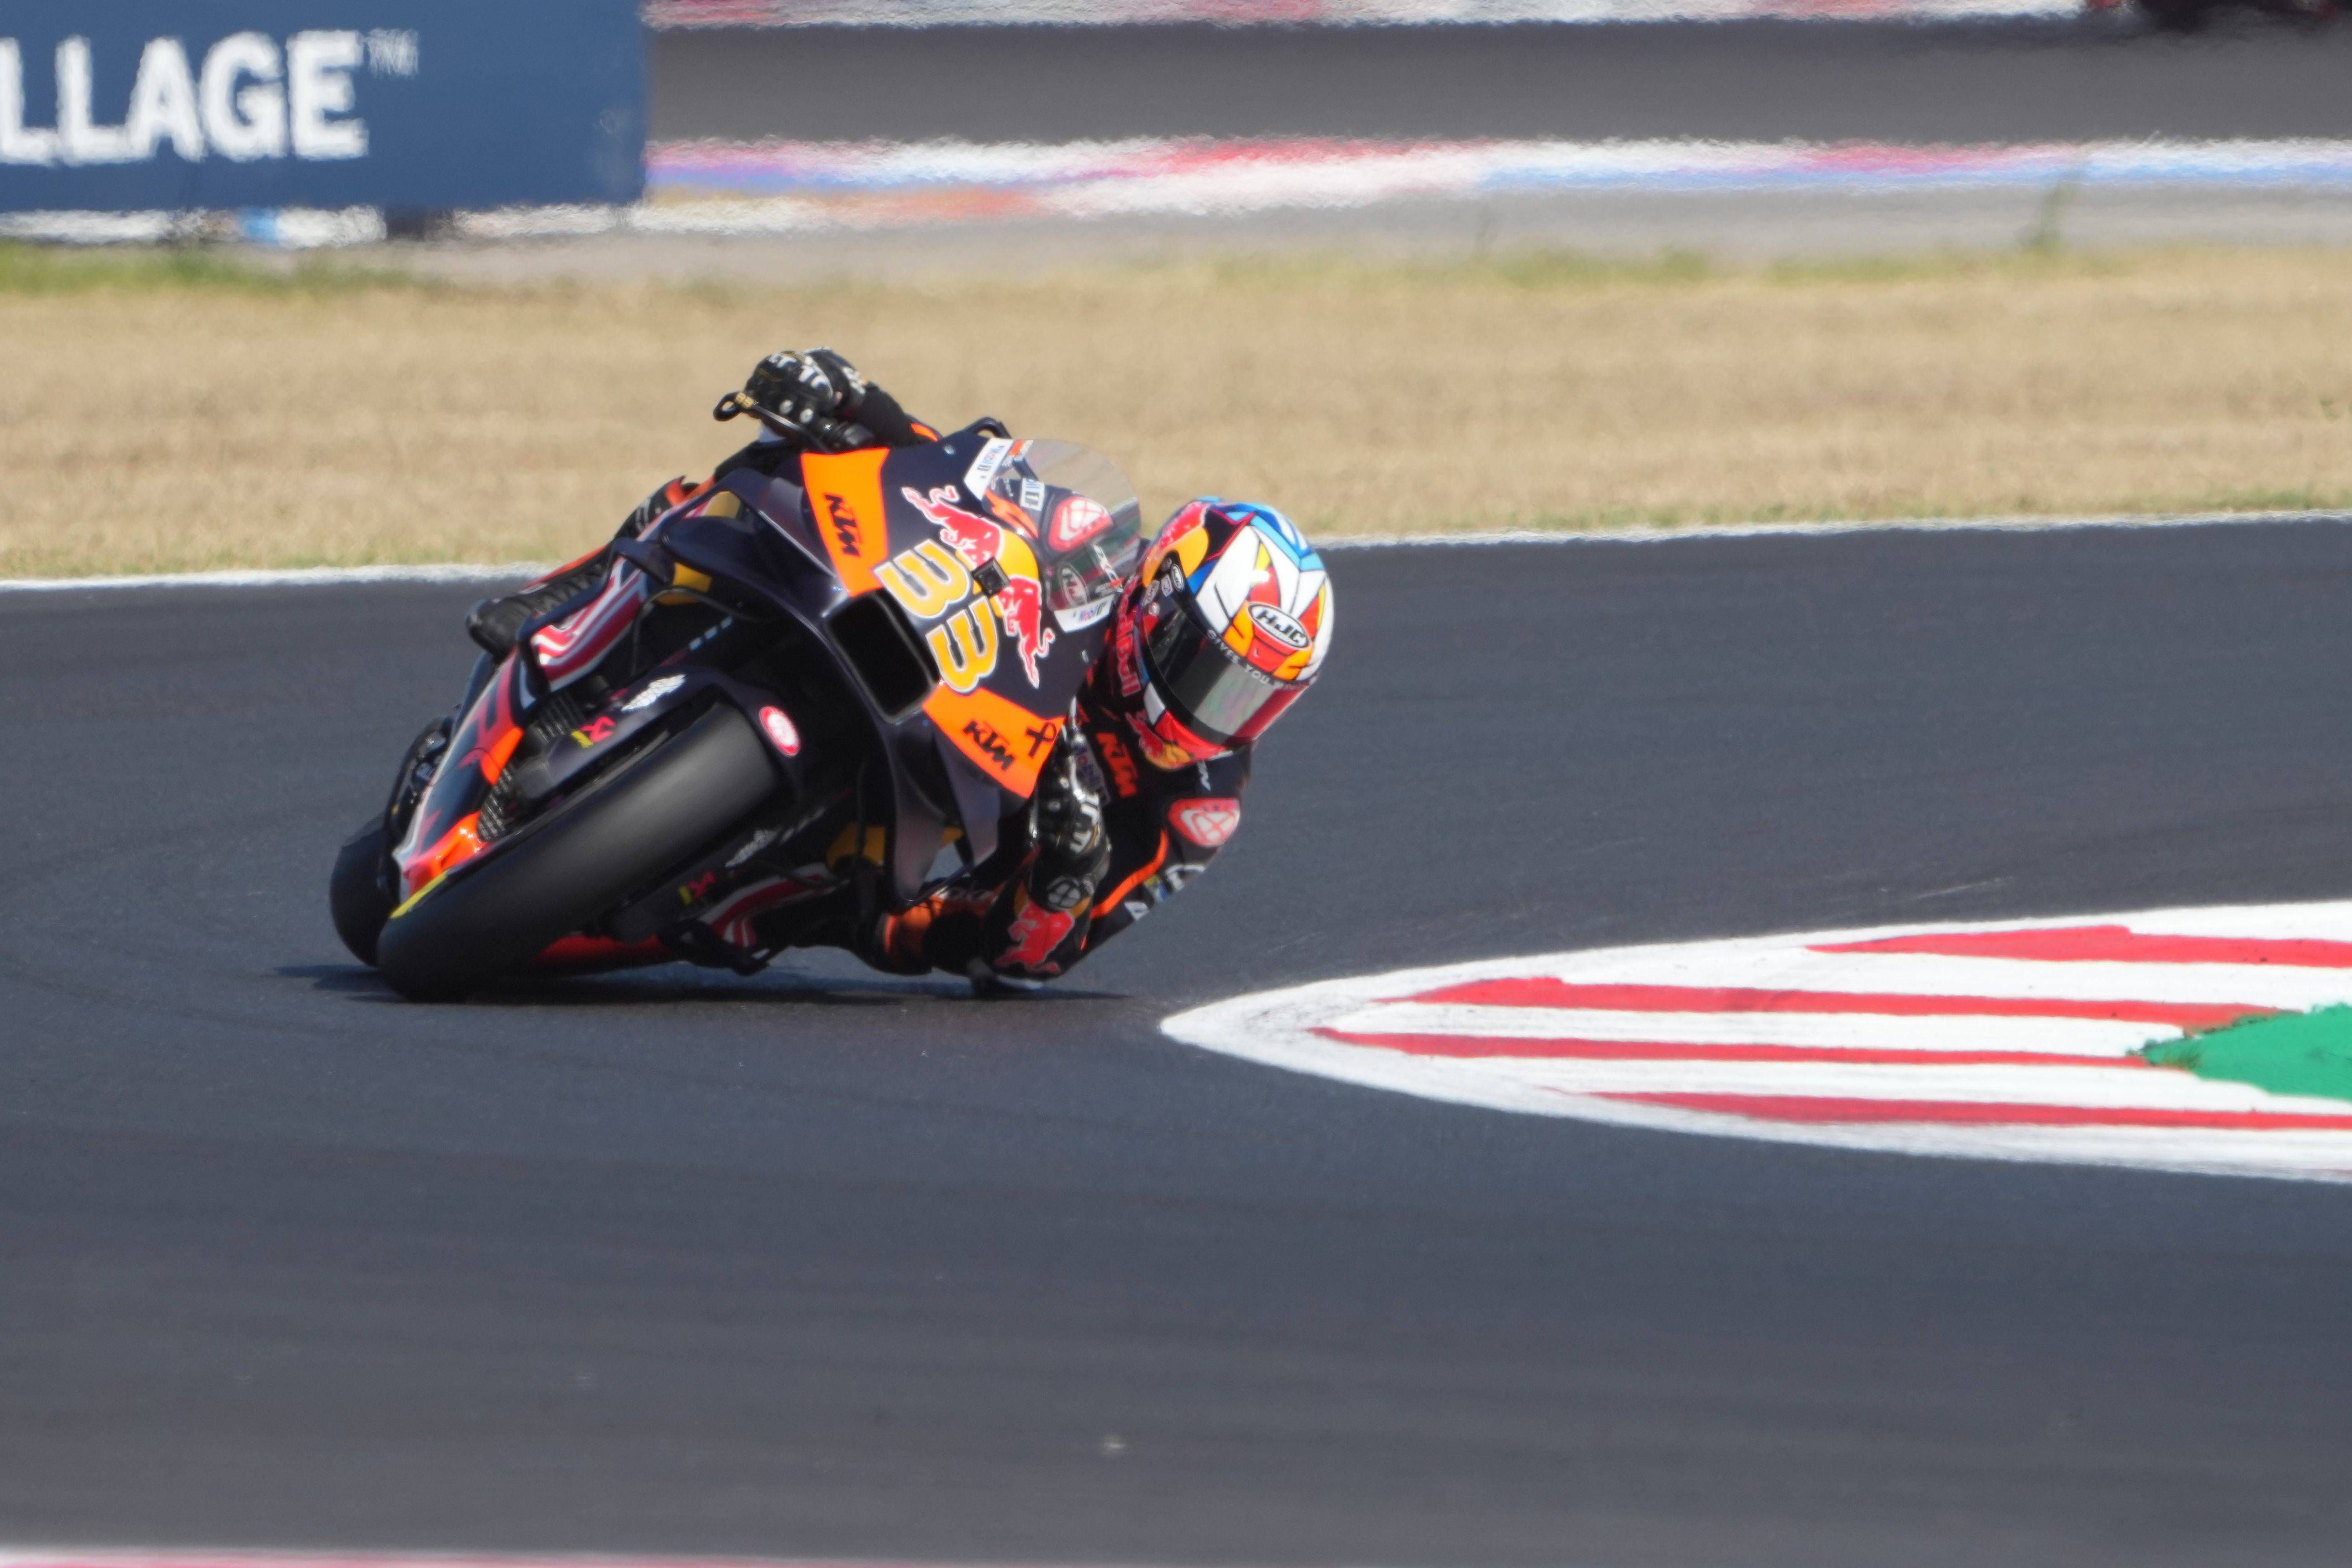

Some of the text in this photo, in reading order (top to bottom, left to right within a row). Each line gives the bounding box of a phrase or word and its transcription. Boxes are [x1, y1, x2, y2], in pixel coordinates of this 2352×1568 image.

[824, 493, 861, 559] KTM
[874, 539, 999, 693] 33
[1255, 609, 1307, 644] HJC
[1207, 629, 1270, 684] GIVES YOU
[962, 719, 1017, 769] KTM
[1095, 732, 1138, 798] KTM
